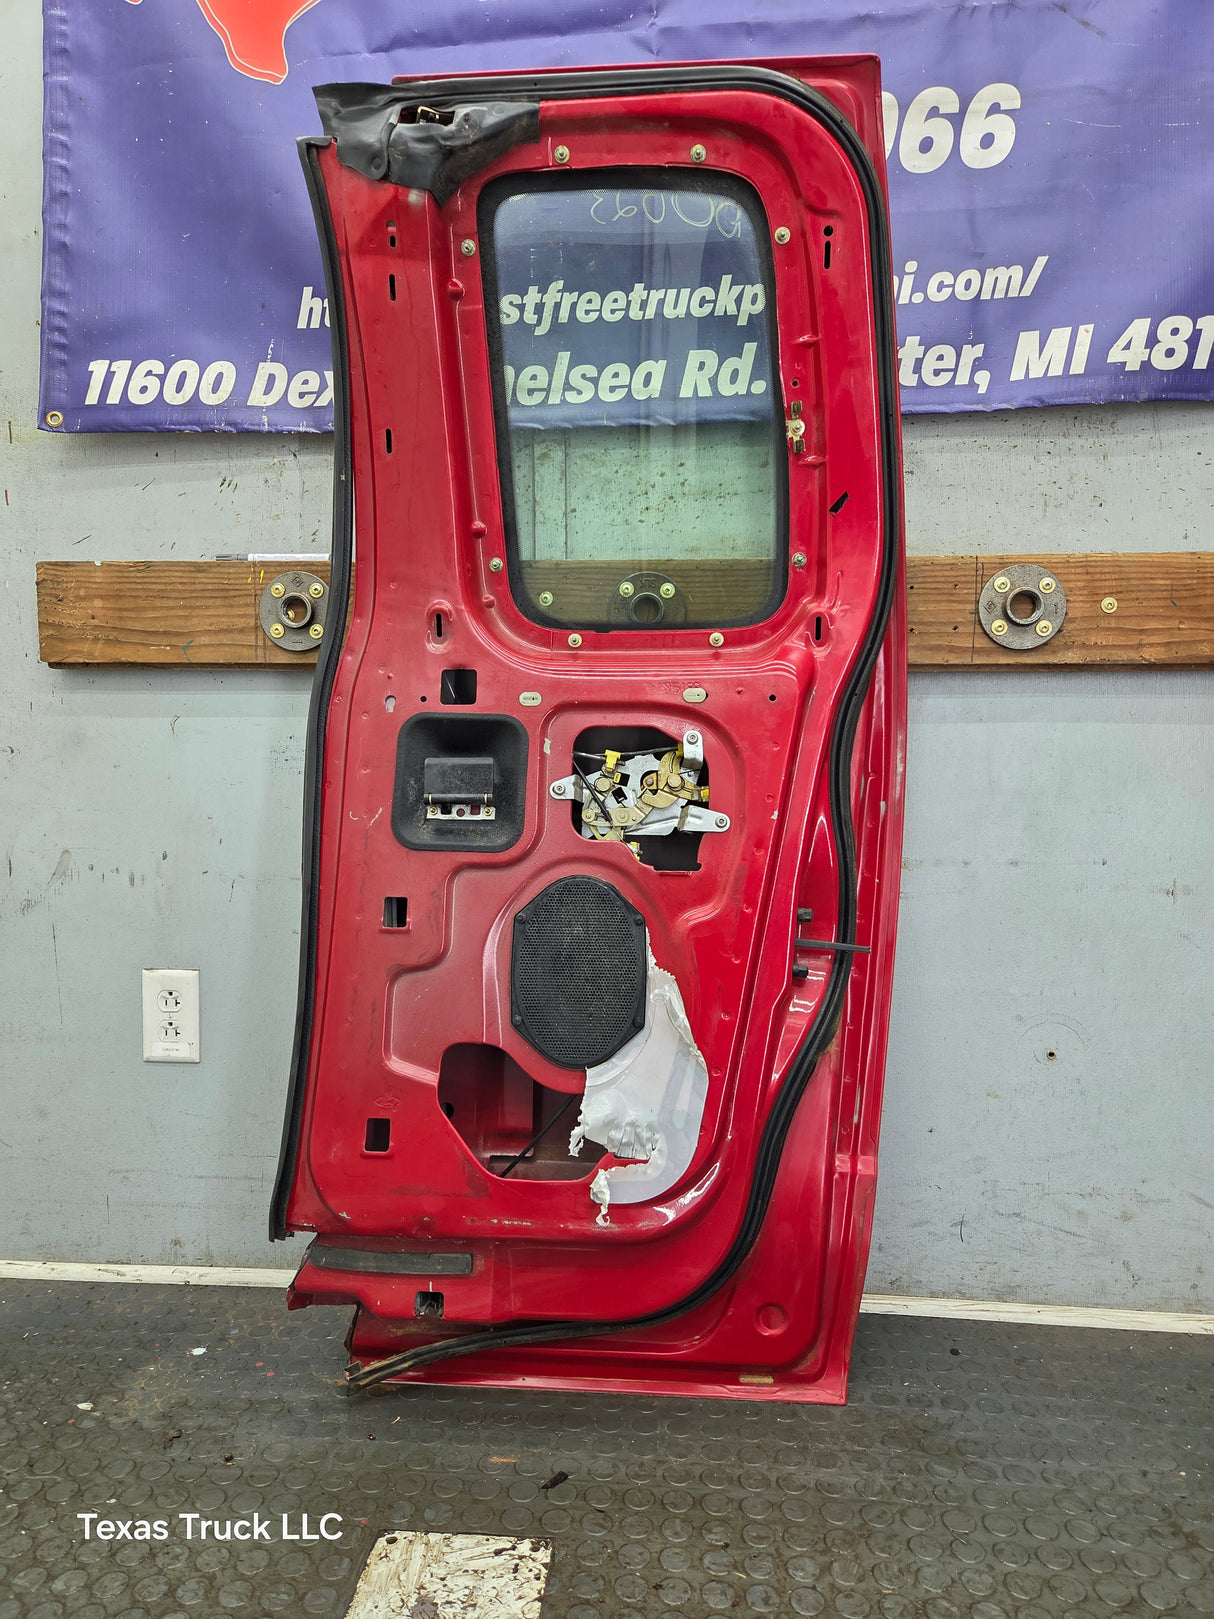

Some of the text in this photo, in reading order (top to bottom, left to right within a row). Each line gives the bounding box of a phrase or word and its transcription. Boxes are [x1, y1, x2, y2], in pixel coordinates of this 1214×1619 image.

[893, 255, 1049, 305] i.com/
[84, 359, 236, 406] 11600
[679, 342, 767, 398] Rd.
[1009, 323, 1095, 382] MI
[1106, 315, 1214, 371] 481
